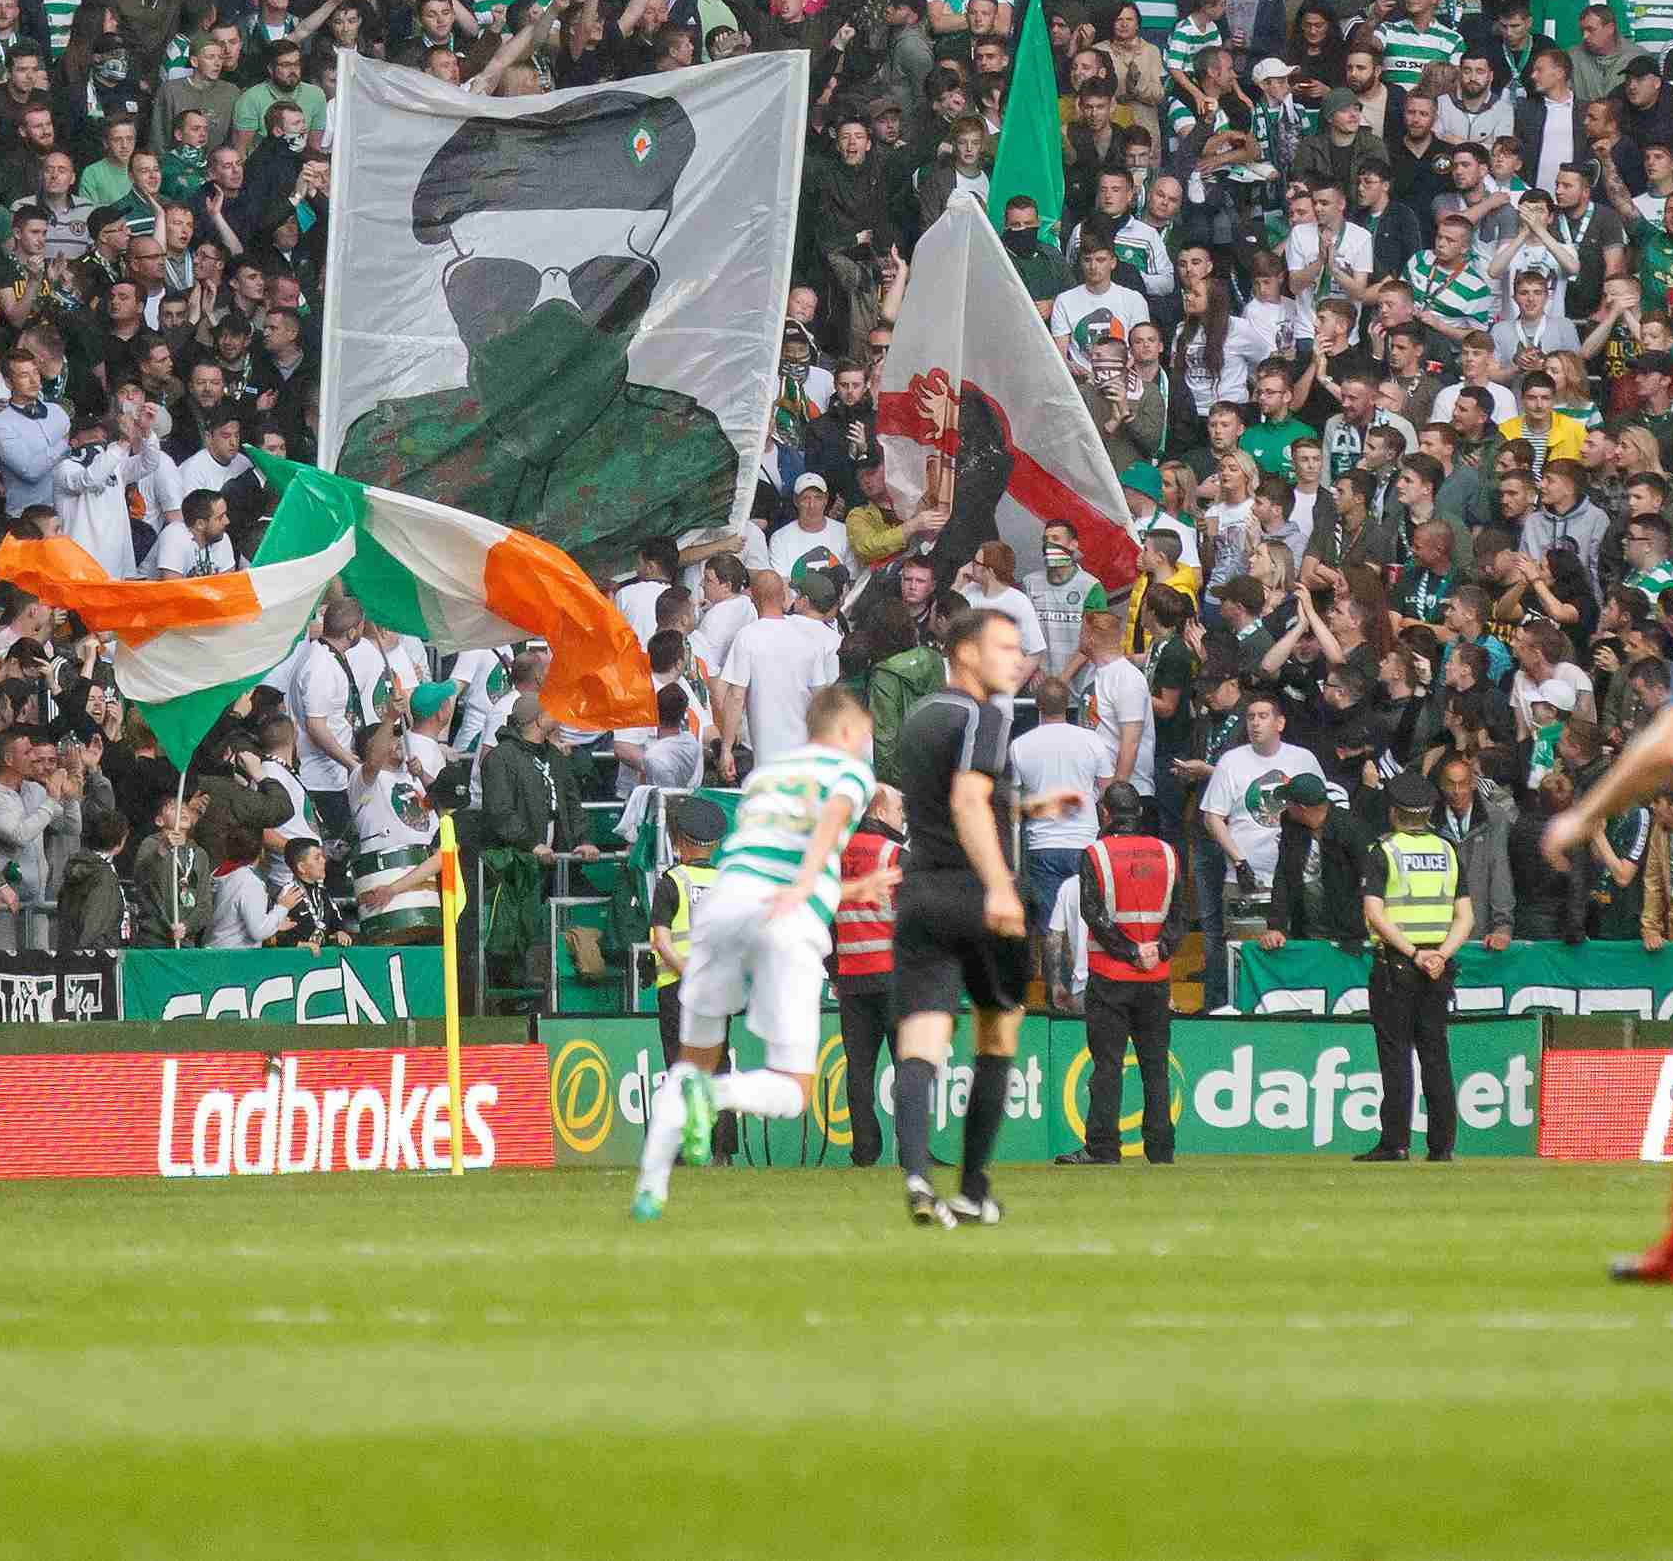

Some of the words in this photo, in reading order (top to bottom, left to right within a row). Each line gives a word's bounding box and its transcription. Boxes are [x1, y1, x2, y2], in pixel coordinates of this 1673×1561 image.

[1401, 852, 1449, 871] POLICE
[158, 1053, 498, 1178] Ladbrokes
[1195, 1044, 1535, 1148] dafaet
